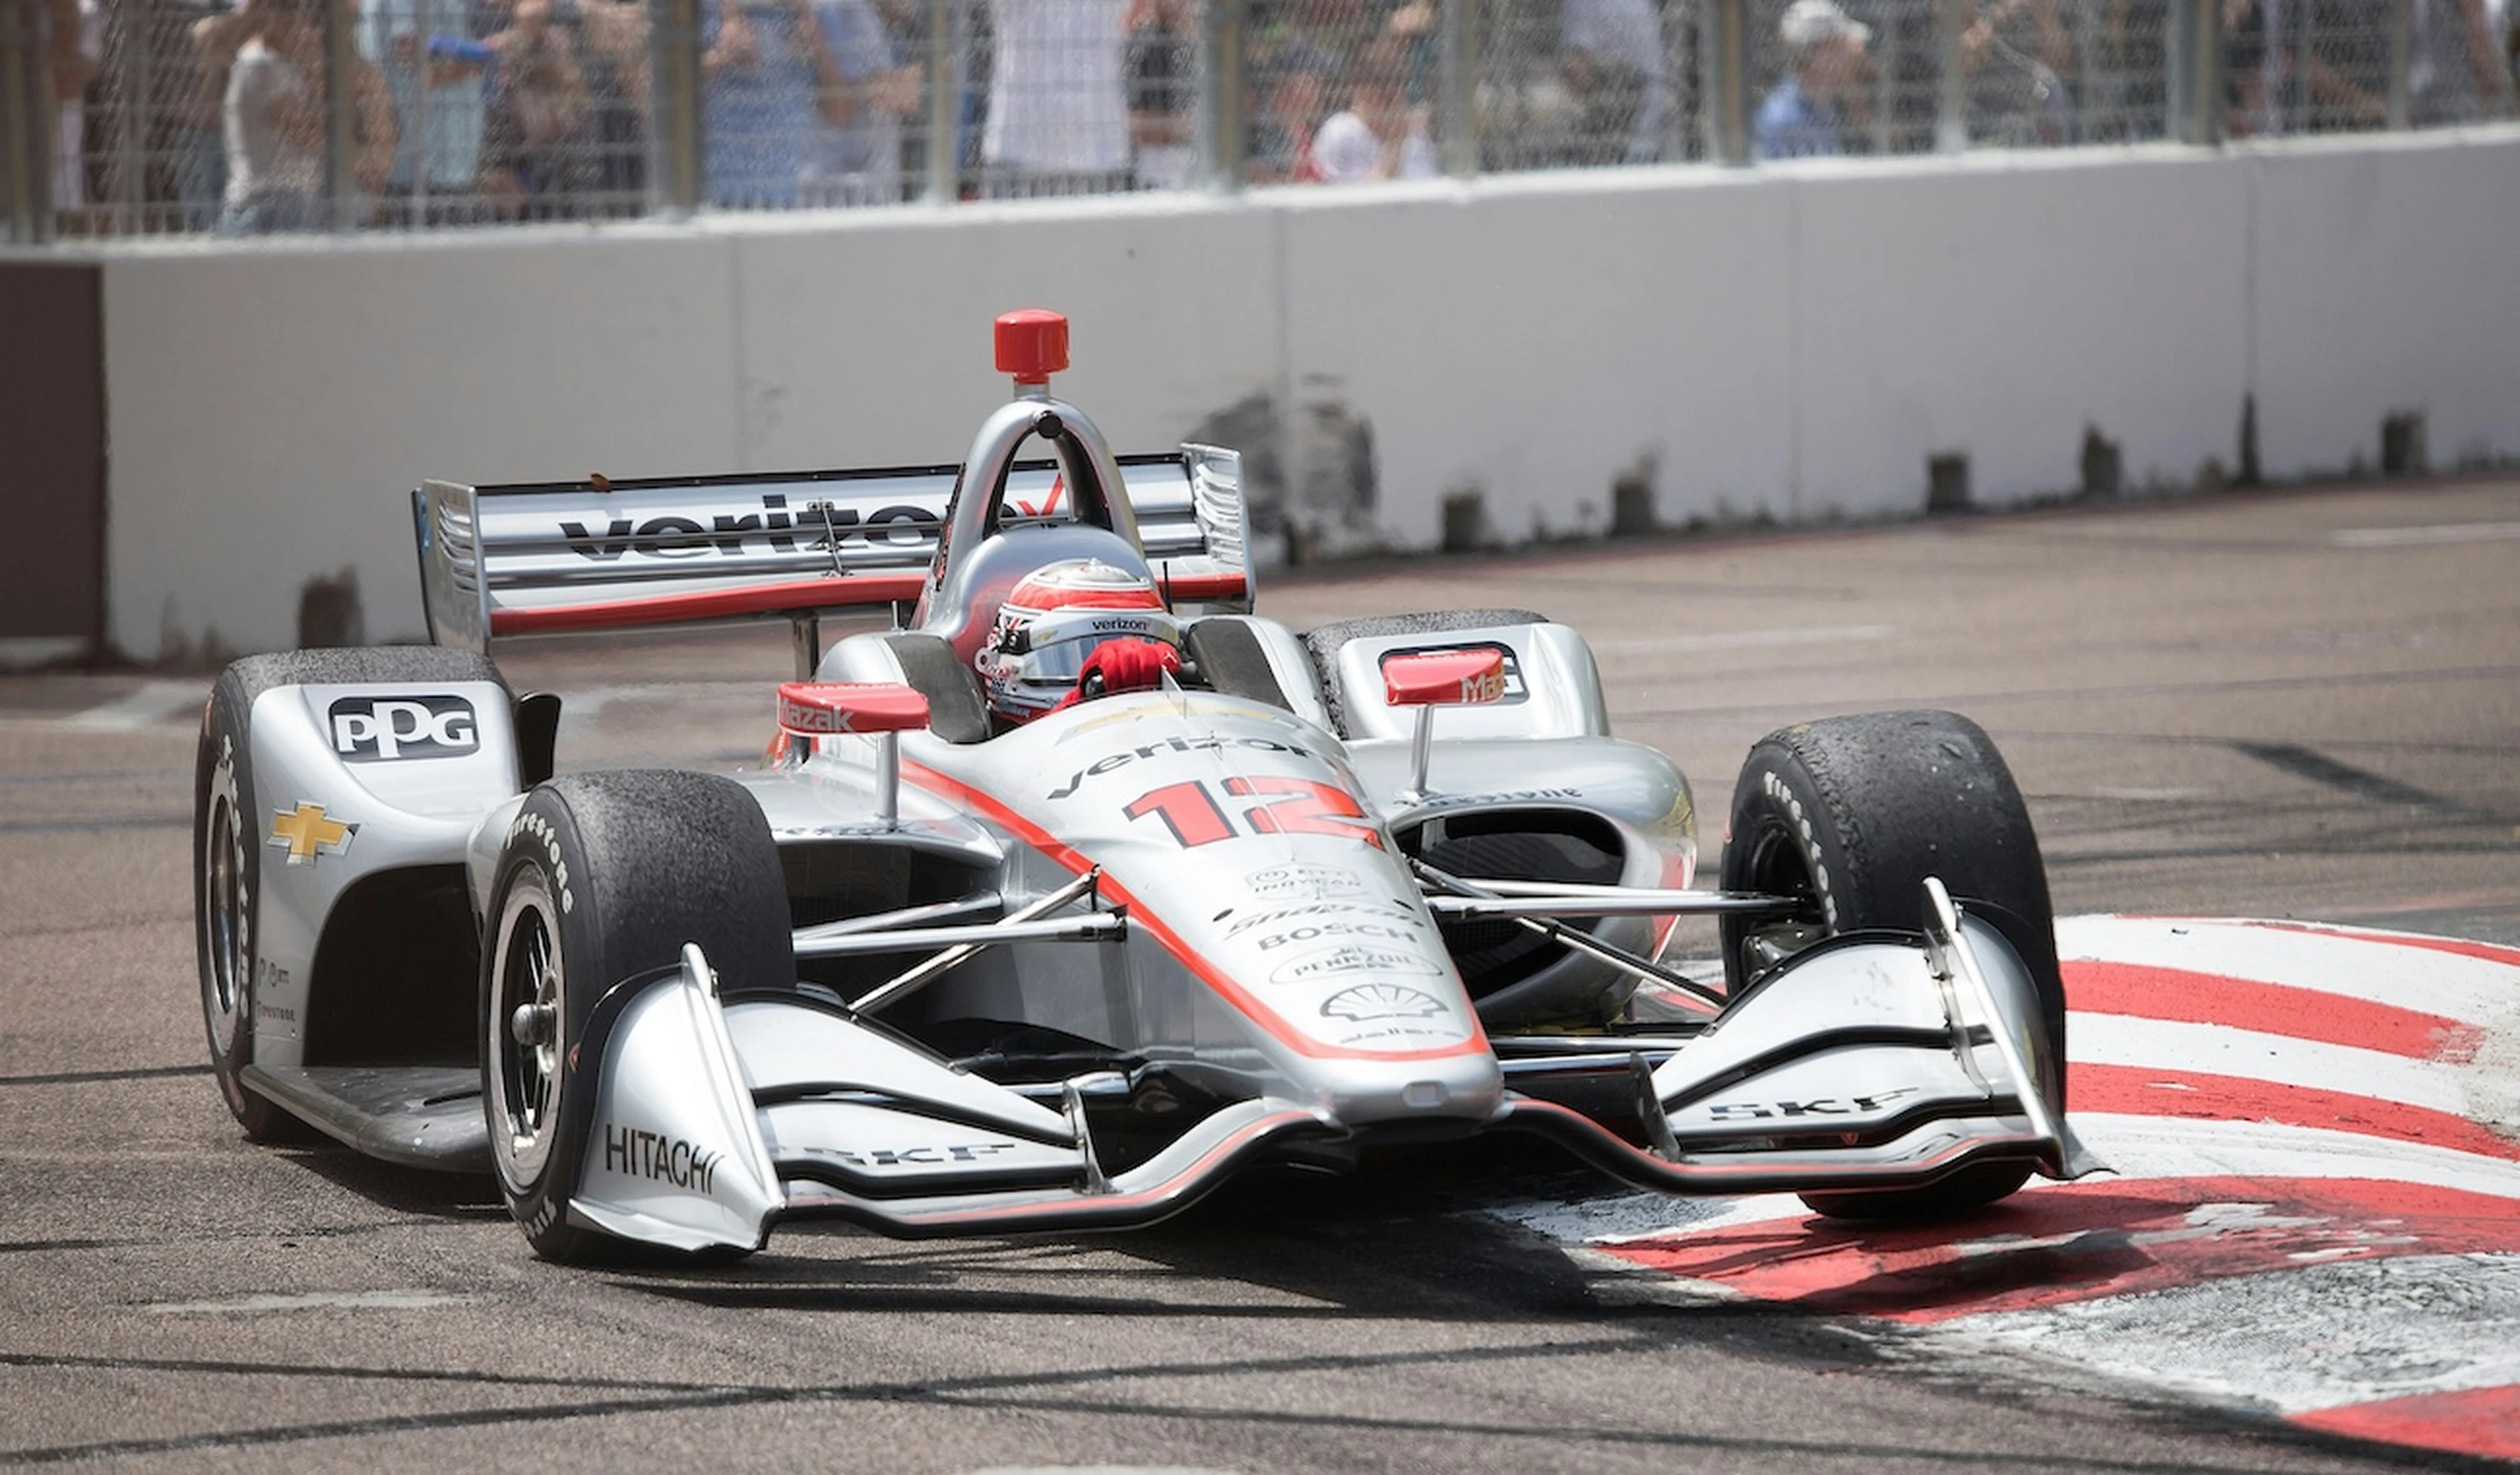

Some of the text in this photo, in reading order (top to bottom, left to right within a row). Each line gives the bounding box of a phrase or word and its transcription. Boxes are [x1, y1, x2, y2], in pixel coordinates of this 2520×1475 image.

[558, 494, 1016, 561] verizo
[1092, 617, 1146, 631] verizon
[335, 701, 474, 758] PPG
[1047, 736, 1312, 800] verizon
[1122, 774, 1387, 852] 12
[507, 813, 573, 914] Firestone
[1764, 771, 1840, 937] Fireston
[1258, 921, 1418, 951] BOSCH
[1710, 1087, 1919, 1121] SKF
[606, 1124, 725, 1195] HITACHI
[804, 1144, 1015, 1166] SKF
